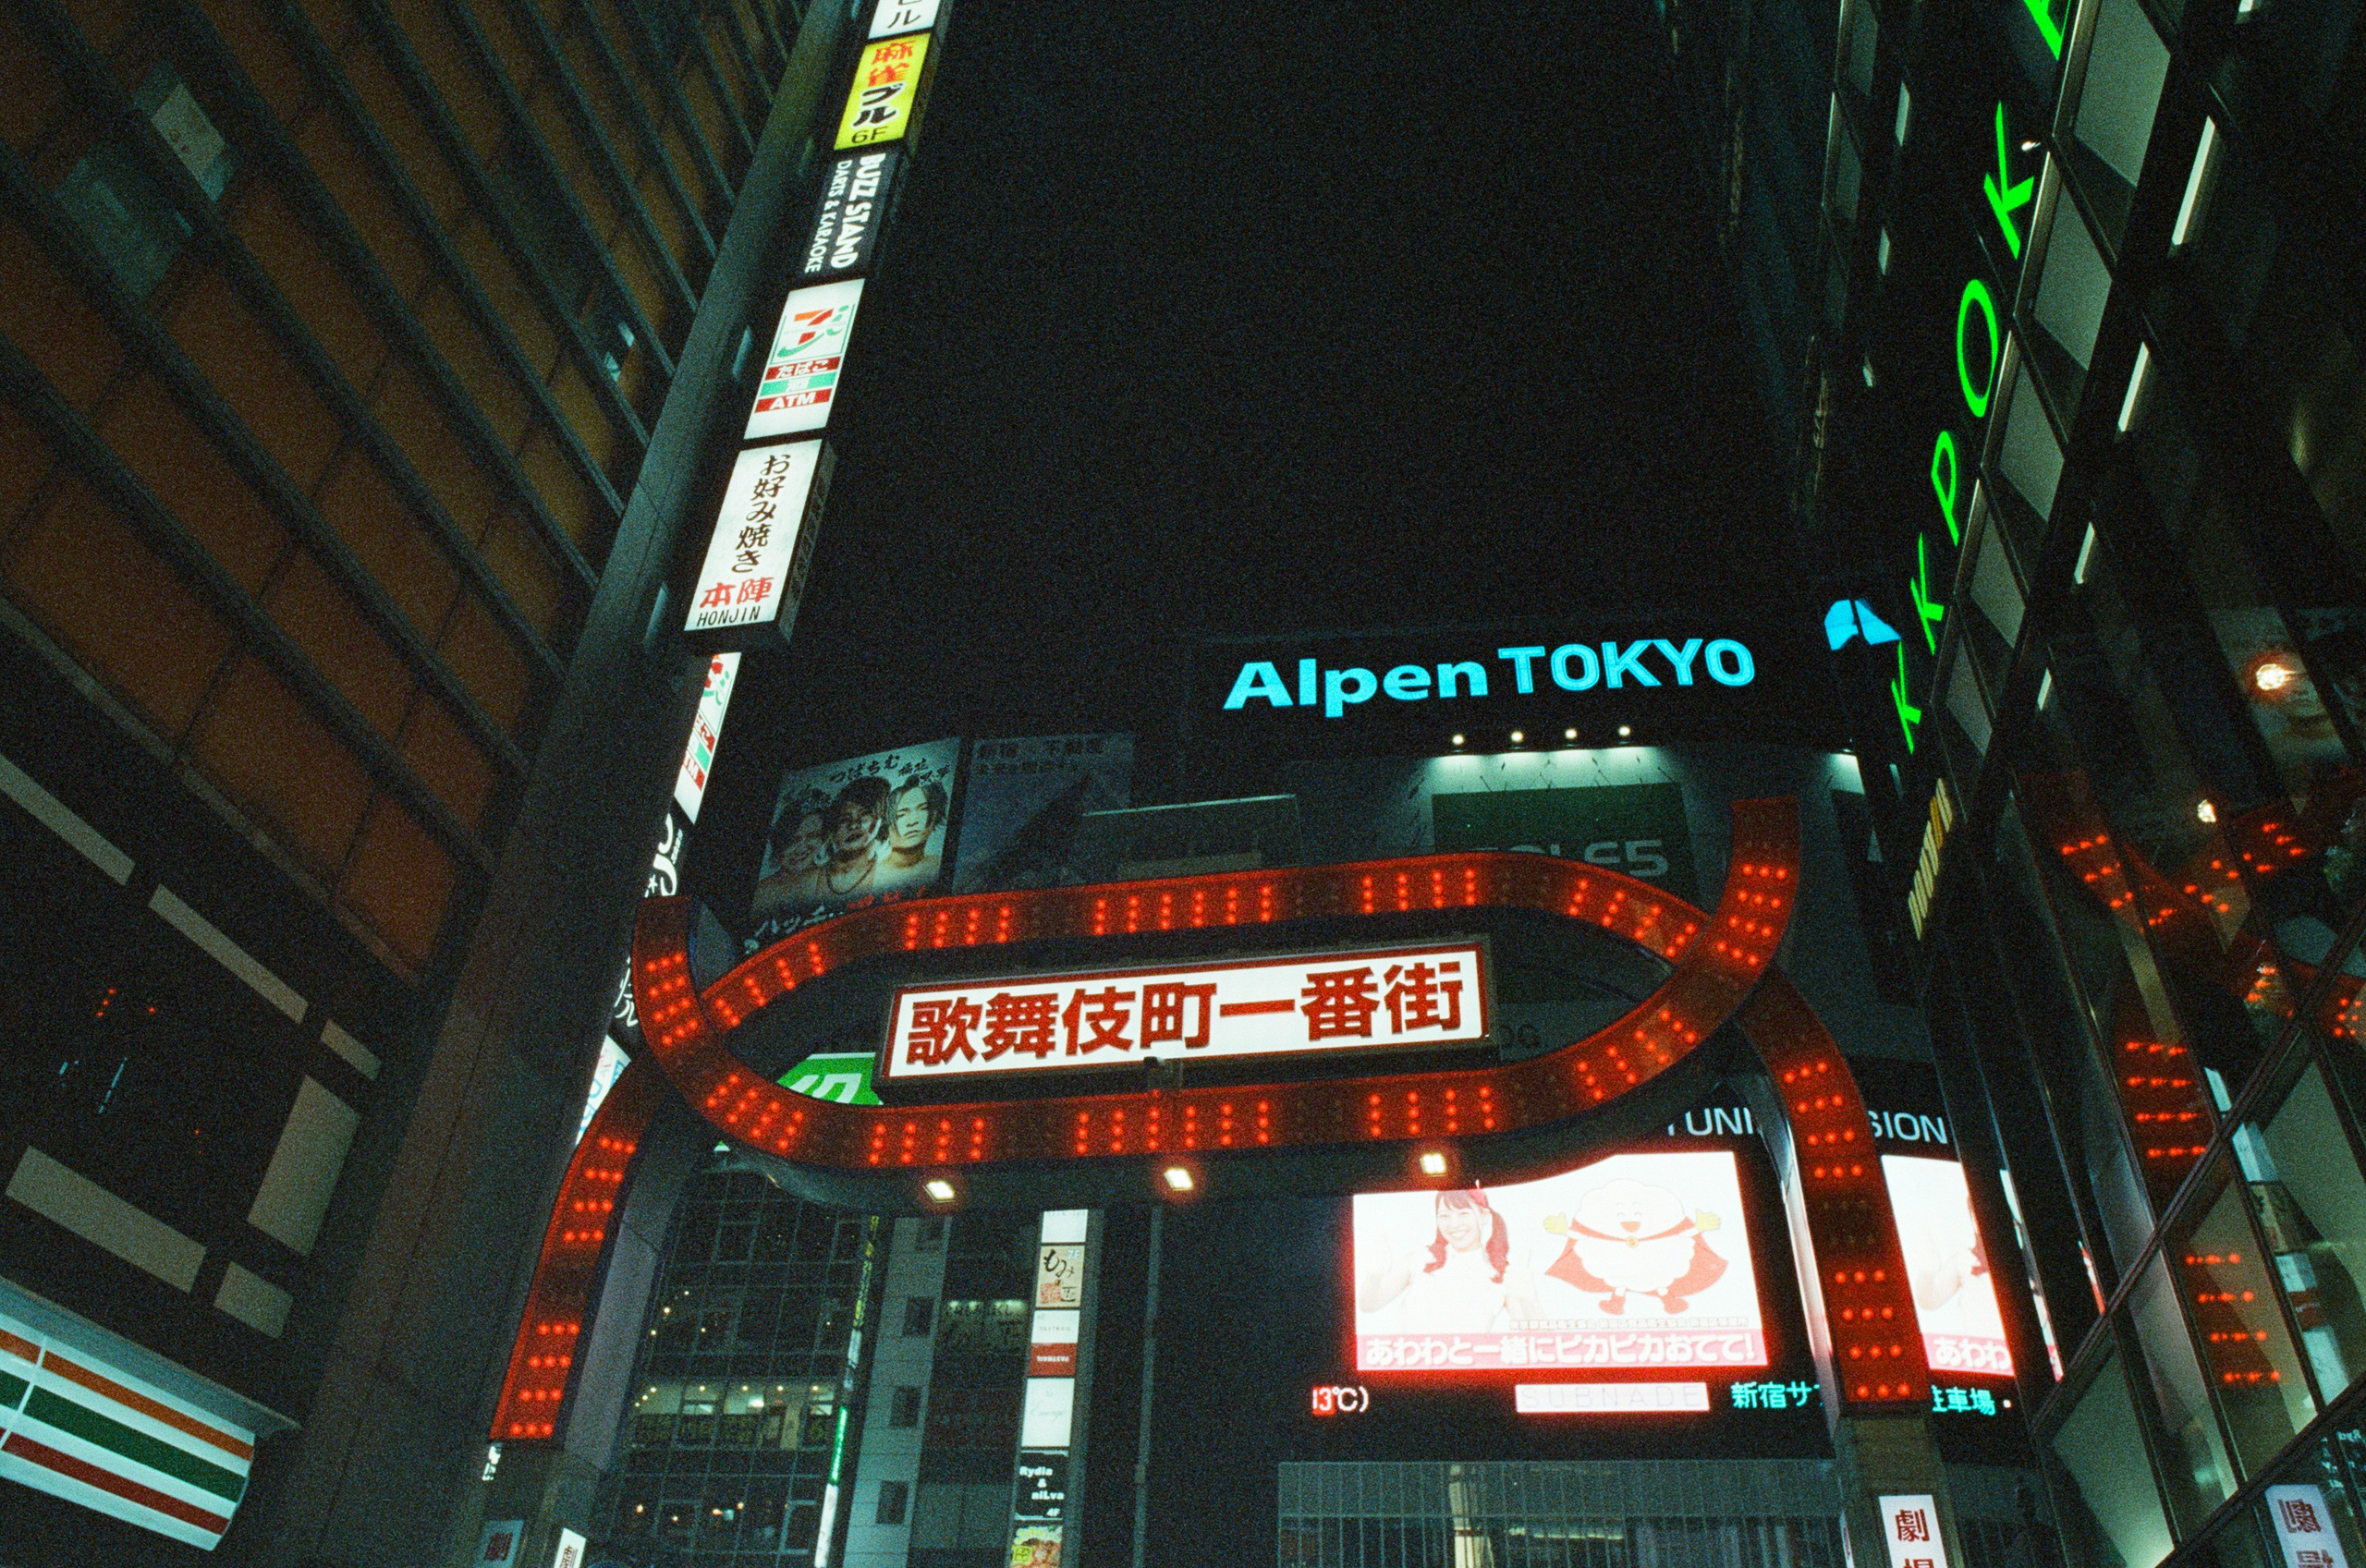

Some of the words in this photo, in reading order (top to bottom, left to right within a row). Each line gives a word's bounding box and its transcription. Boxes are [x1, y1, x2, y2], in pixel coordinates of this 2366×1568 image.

[851, 127, 888, 144] 6F
[827, 159, 853, 198] DARTS
[848, 152, 886, 201] BUZZ
[804, 212, 837, 273] KARAOKE
[830, 201, 872, 269] STAND
[776, 359, 830, 380] たばこ
[769, 392, 817, 410] ATM
[731, 454, 791, 573] お好み焼き
[700, 577, 774, 609] 本陣
[696, 605, 762, 627] HONJIN
[1223, 658, 1488, 718] Alpen
[1497, 638, 1755, 695] TOKYO
[907, 961, 1462, 1065] 歌舞伎町一番街
[1933, 1336, 2013, 1369] あわわ
[1730, 1380, 1821, 1409] 新宿サ
